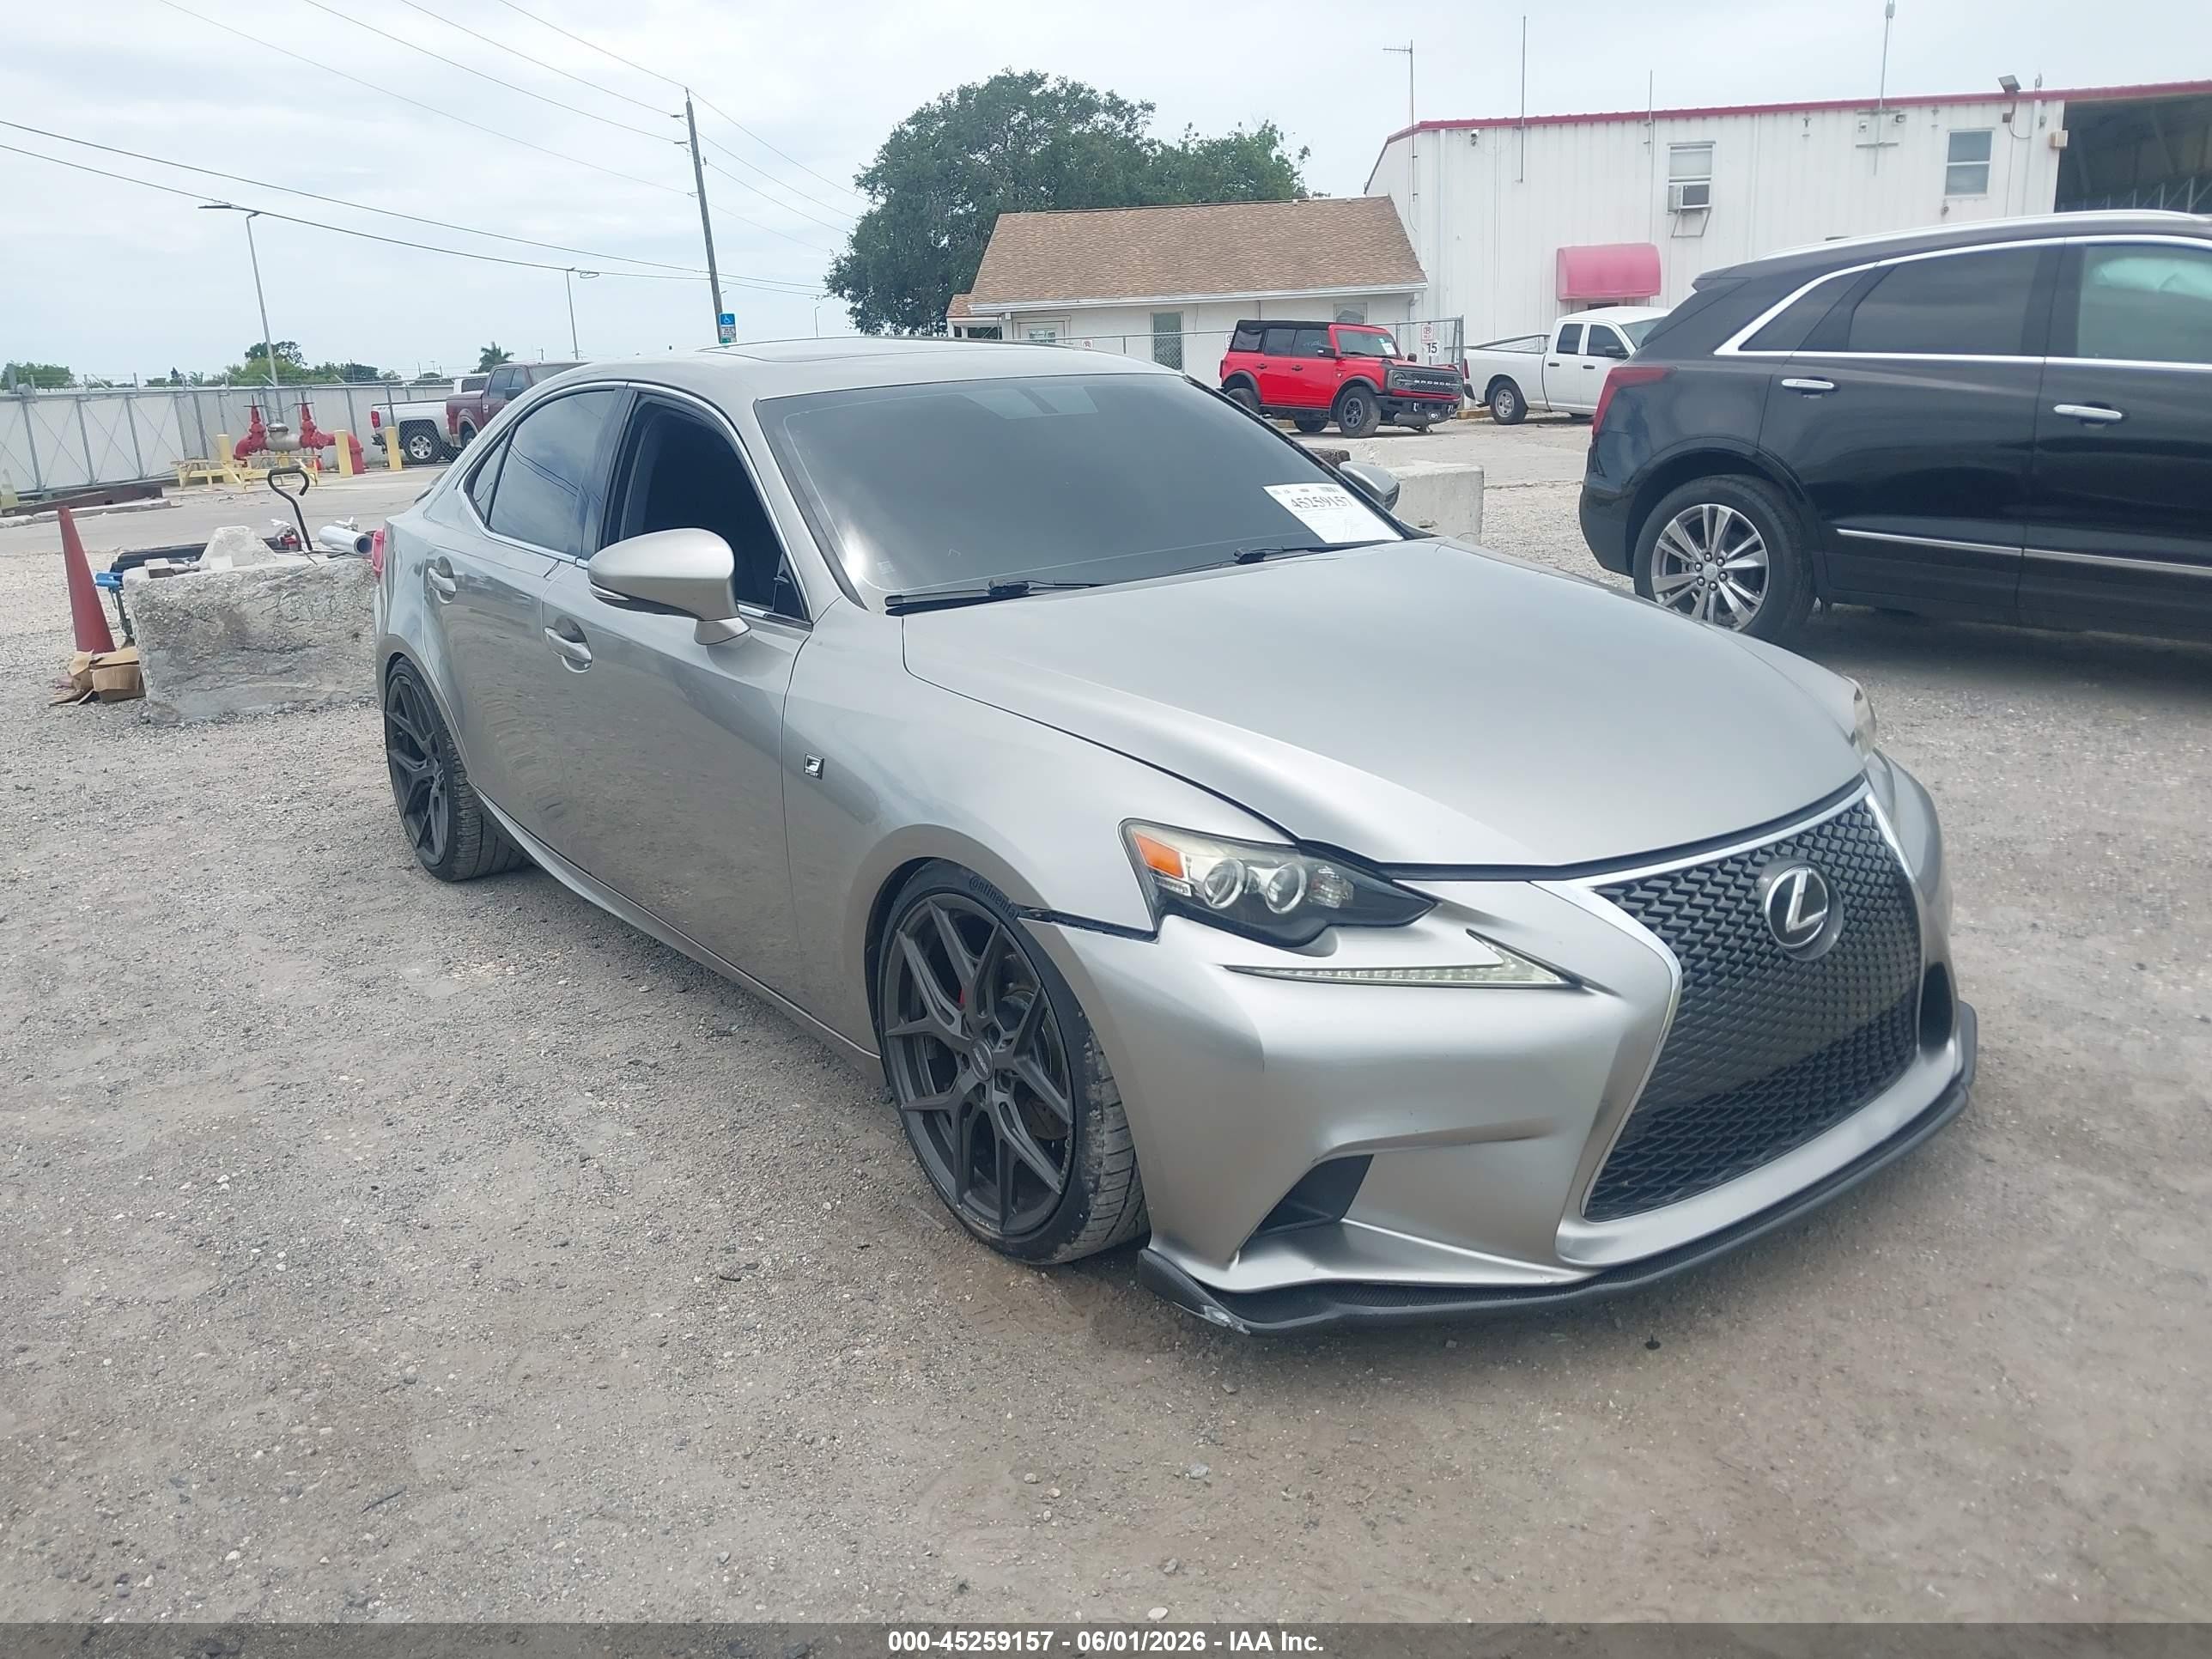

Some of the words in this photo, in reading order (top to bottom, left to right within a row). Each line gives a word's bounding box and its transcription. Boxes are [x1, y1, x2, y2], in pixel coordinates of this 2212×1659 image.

[1427, 343, 1437, 354] 15
[1291, 496, 1353, 508] 45259157
[969, 877, 1020, 921] Continental
